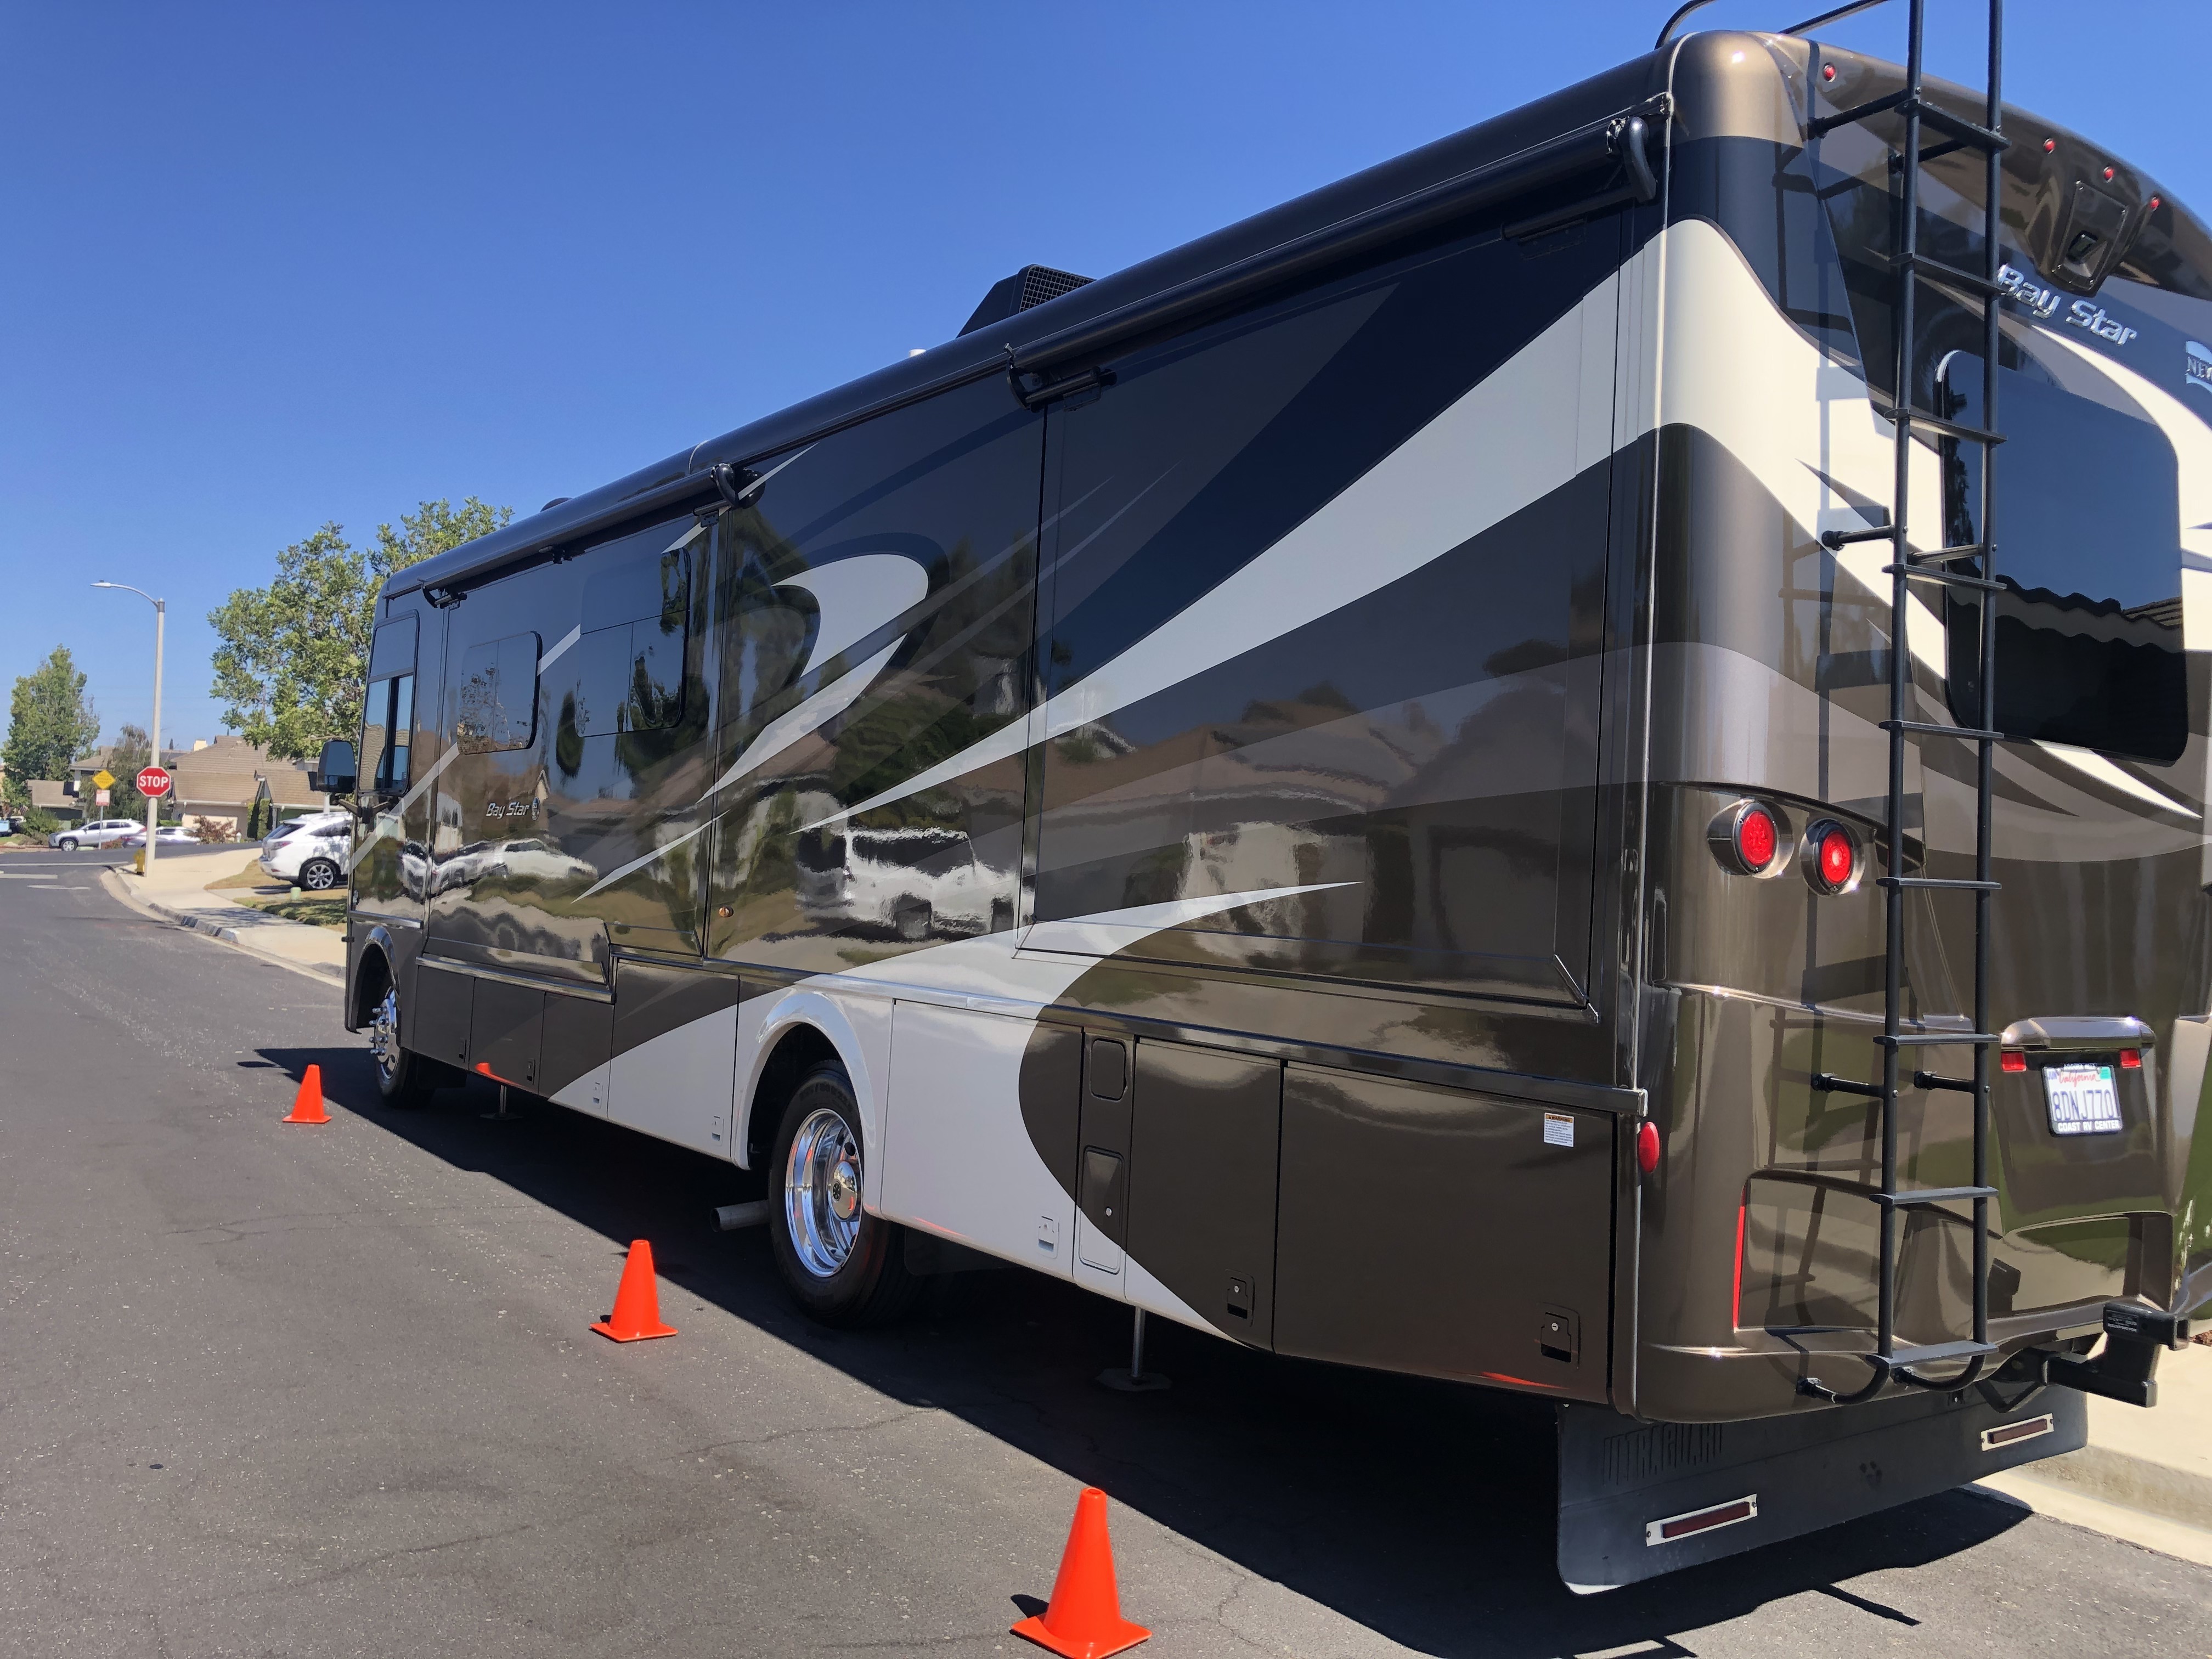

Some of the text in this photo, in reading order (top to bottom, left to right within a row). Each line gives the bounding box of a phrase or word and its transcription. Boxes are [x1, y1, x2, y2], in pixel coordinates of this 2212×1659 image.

[1997, 263, 2137, 346] Bay Star
[139, 775, 168, 788] STOP
[486, 801, 530, 820] Bay Star
[2058, 1070, 2101, 1087] California
[2052, 1090, 2114, 1121] 8DNJ770
[2057, 1120, 2120, 1132] COAST RV CENTER
